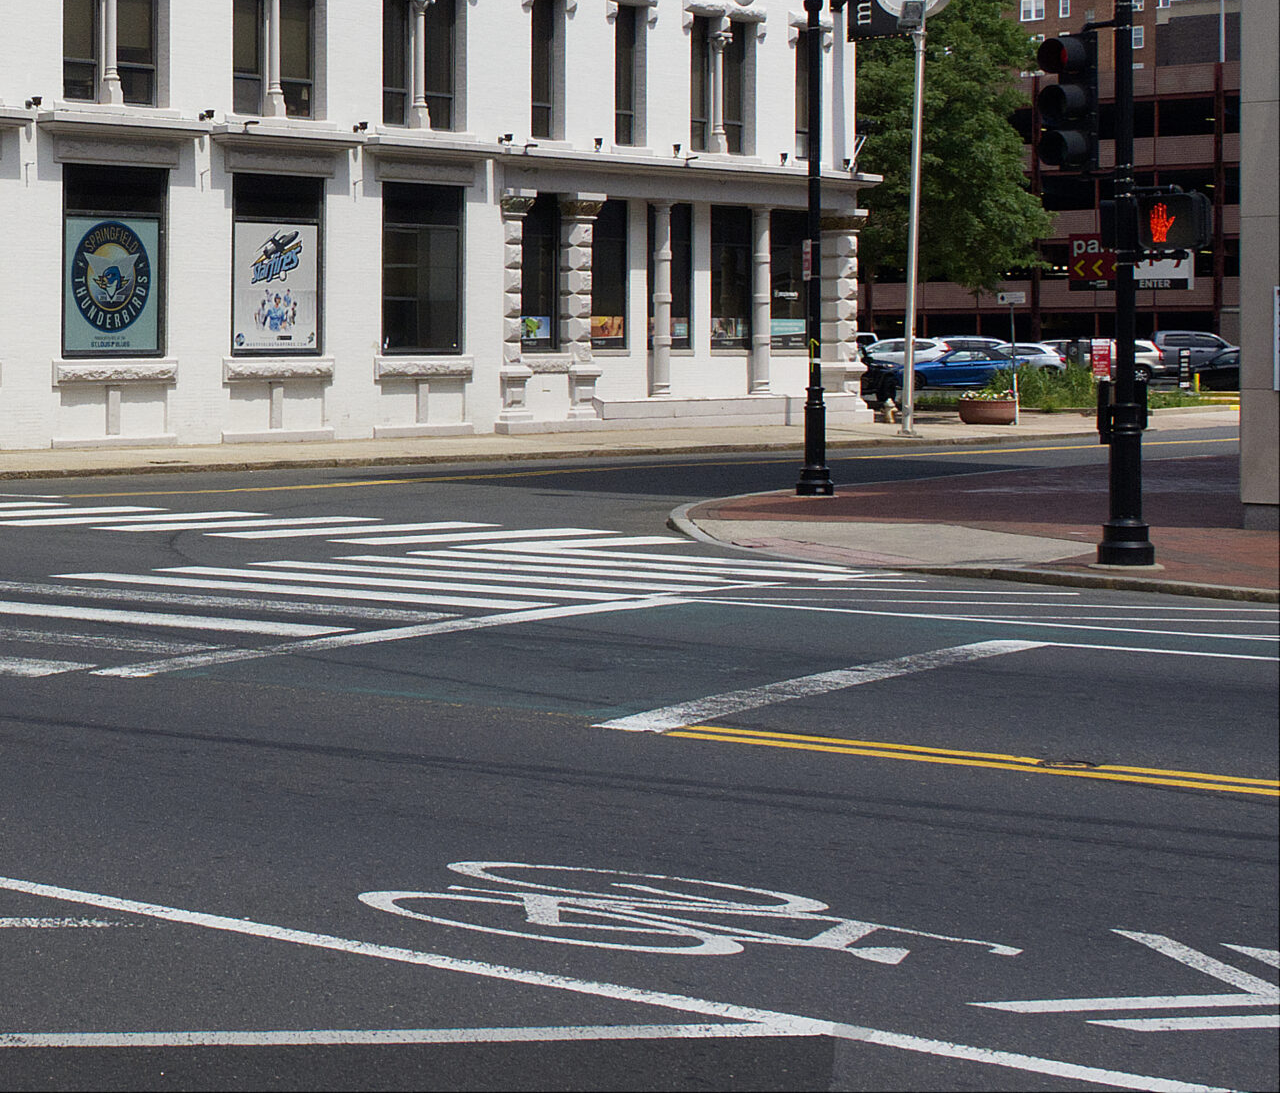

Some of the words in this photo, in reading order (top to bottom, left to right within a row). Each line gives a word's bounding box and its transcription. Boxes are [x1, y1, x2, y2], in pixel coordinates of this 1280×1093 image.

[84, 226, 140, 254] SPRINGFIELD
[251, 246, 303, 283] Starfires
[1139, 280, 1171, 288] ENTER
[74, 275, 149, 329] THUNDERBIRDS
